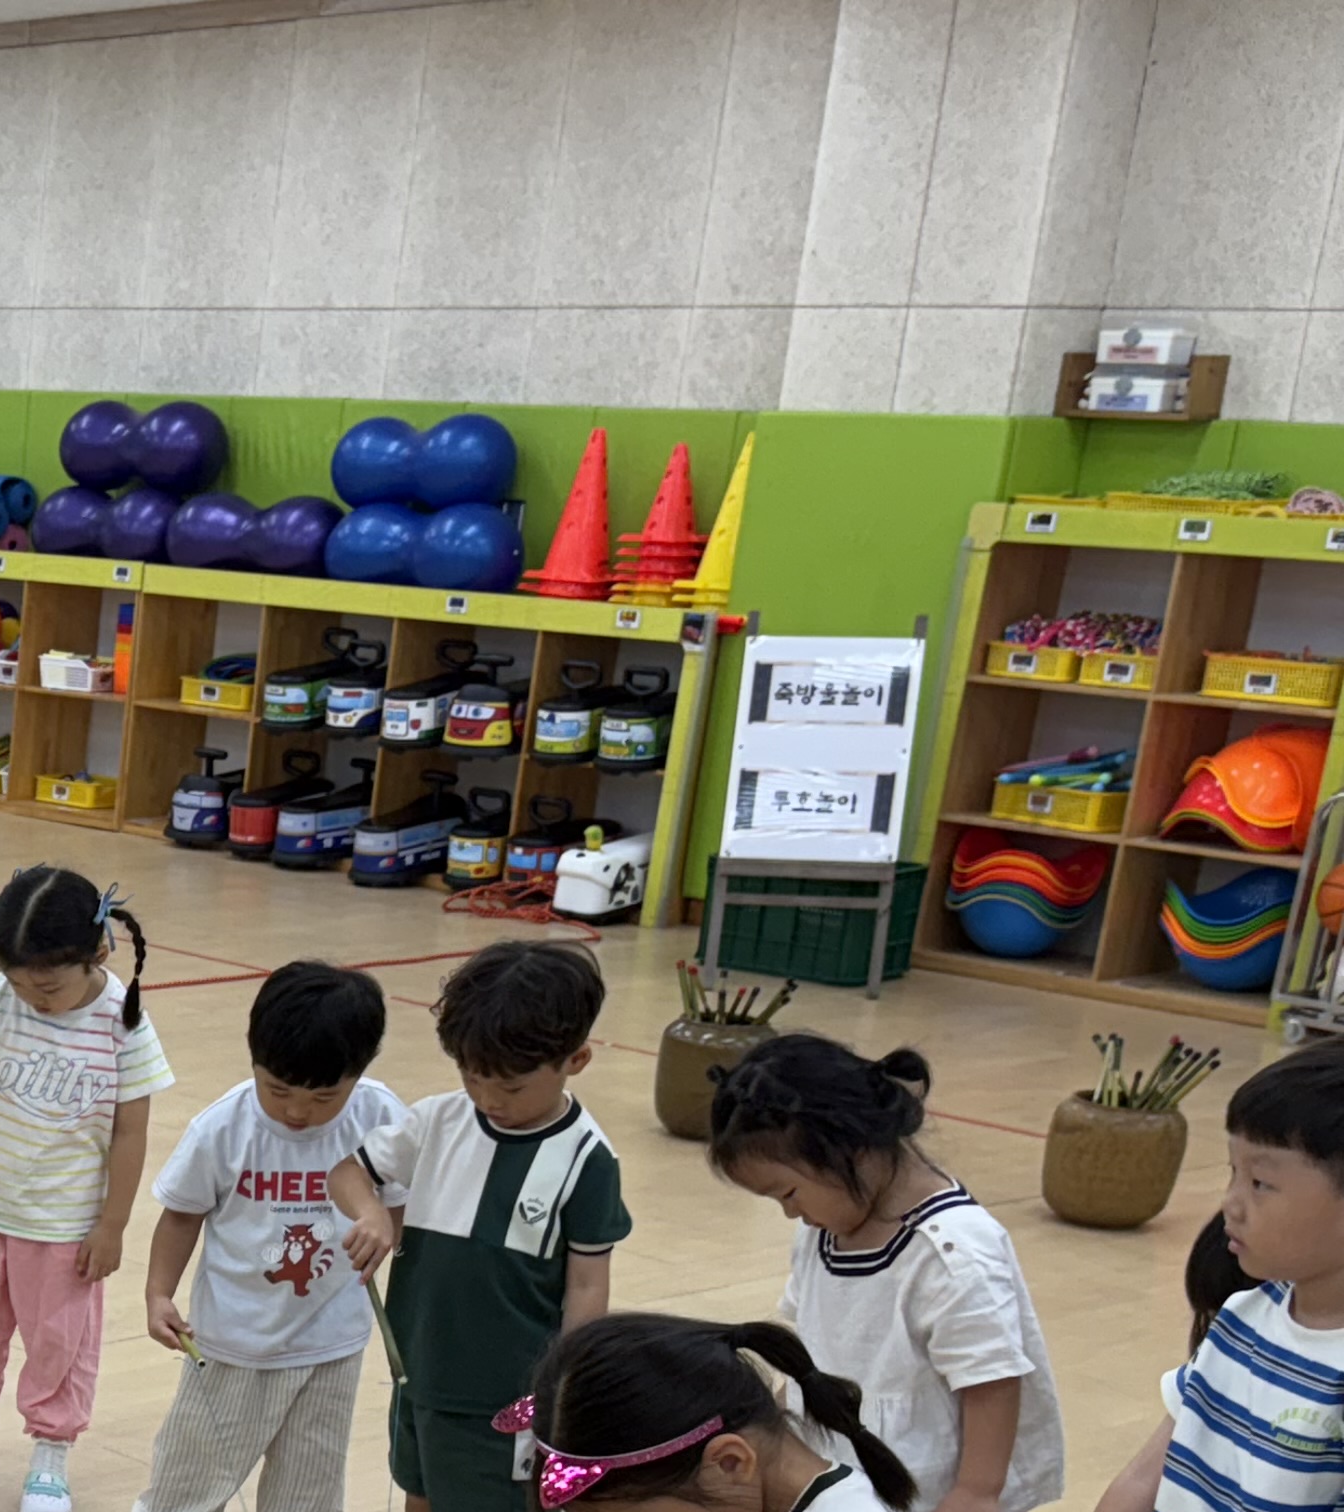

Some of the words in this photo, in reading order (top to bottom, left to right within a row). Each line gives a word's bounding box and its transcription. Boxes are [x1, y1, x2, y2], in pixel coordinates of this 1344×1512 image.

[774, 682, 883, 706] 죽방울놀이
[771, 790, 857, 813] 투호놀이
[237, 1170, 328, 1202] CHEE
